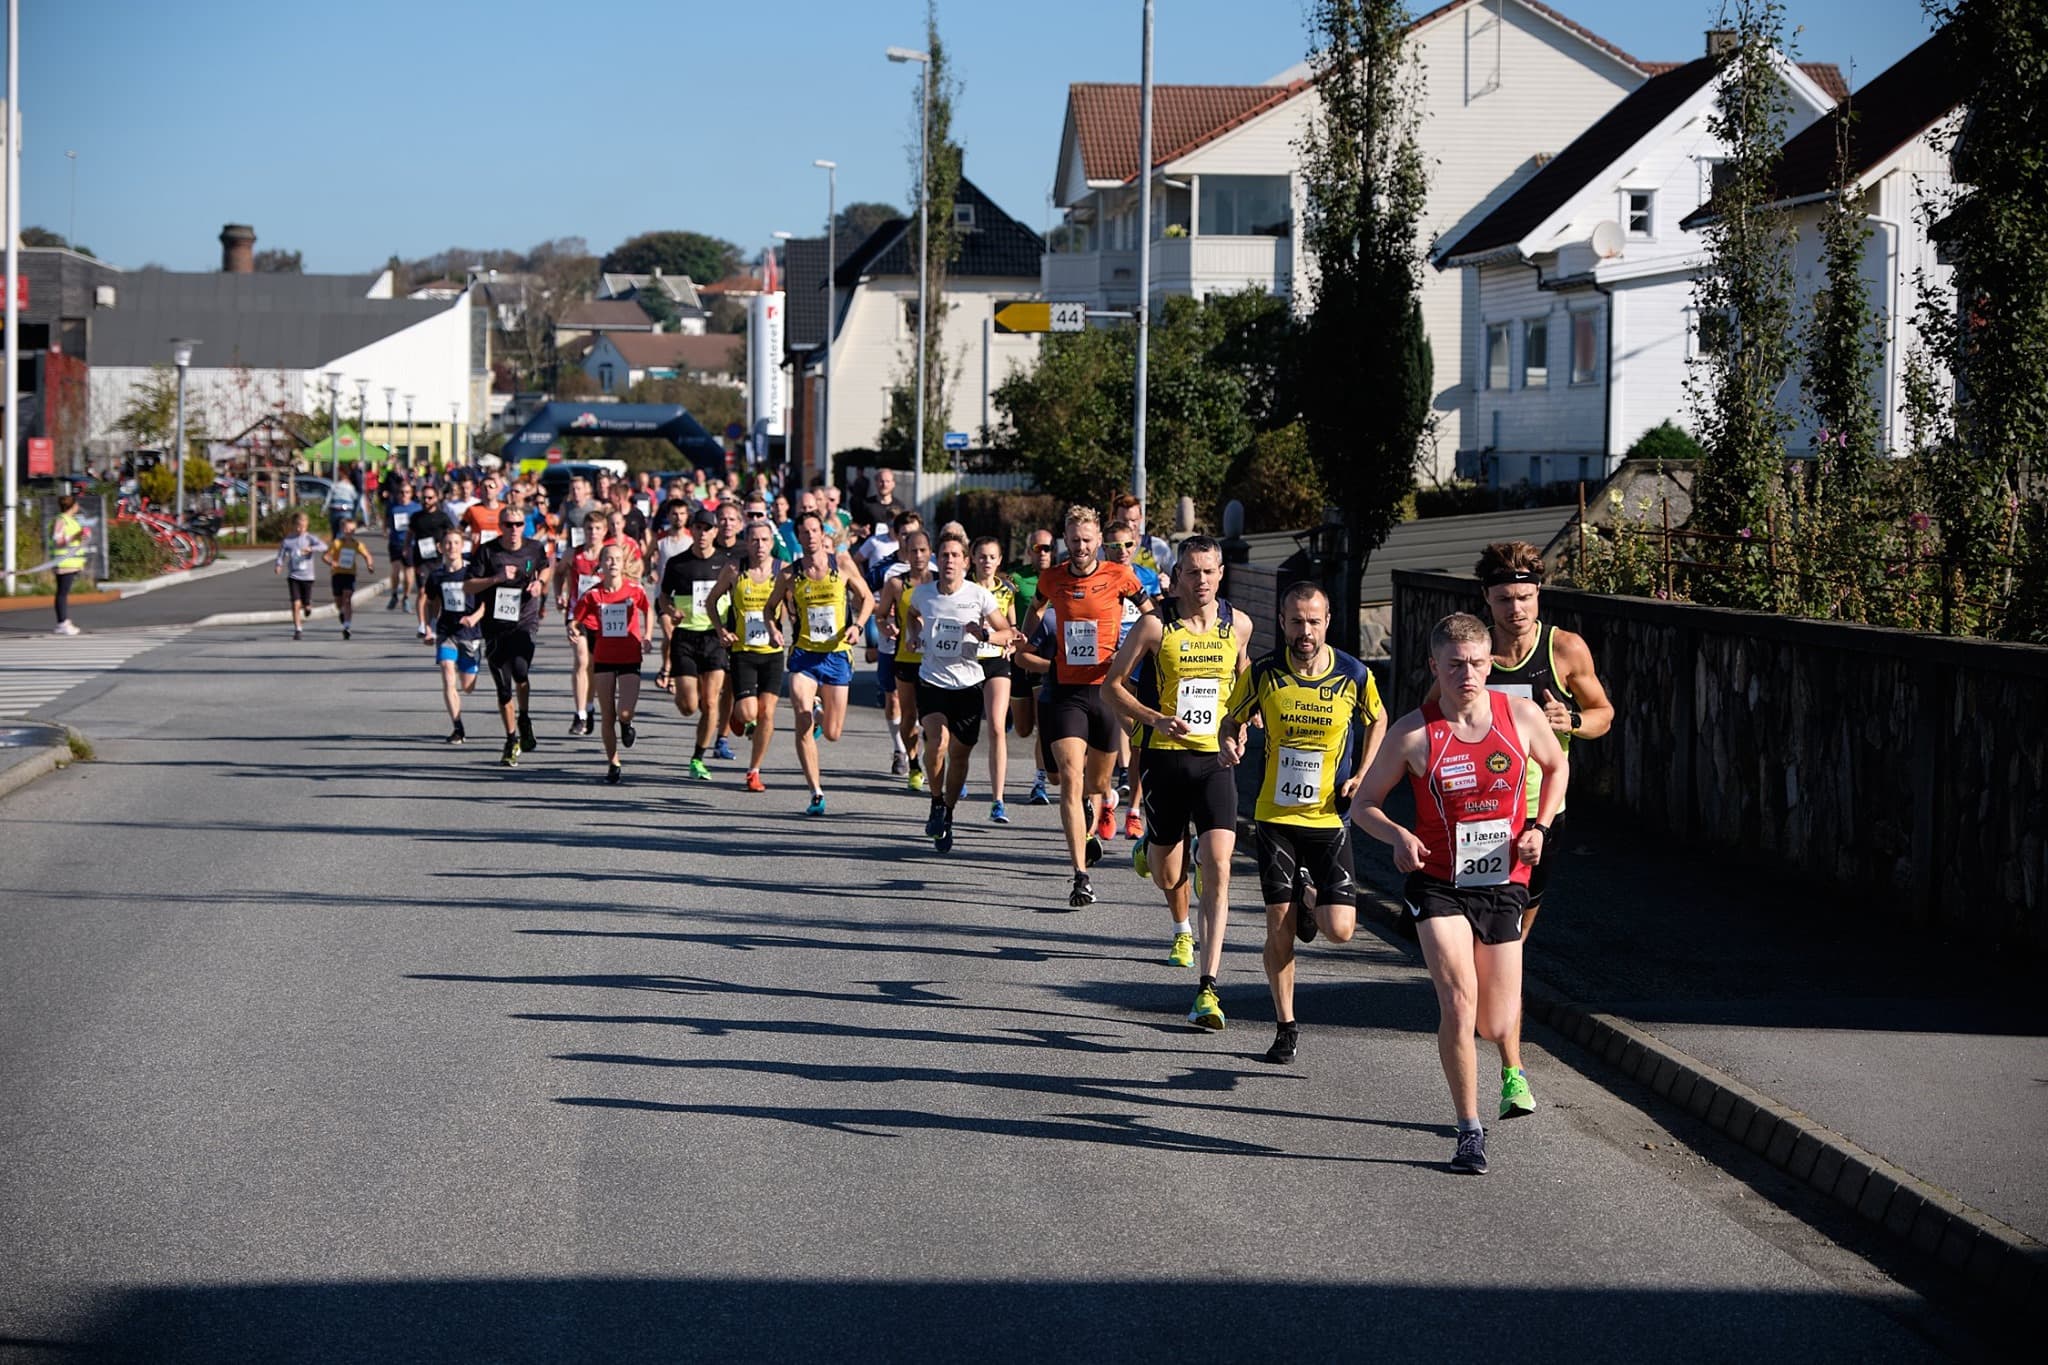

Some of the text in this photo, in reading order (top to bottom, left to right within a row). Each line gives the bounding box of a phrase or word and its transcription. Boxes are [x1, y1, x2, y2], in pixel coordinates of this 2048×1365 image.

[1057, 310, 1078, 324] 44
[498, 605, 516, 615] 420
[606, 621, 625, 631] 317
[814, 625, 833, 634] 464
[936, 640, 958, 651] 467
[1070, 645, 1096, 657] 422
[1190, 641, 1223, 650] FATLAND
[1179, 655, 1223, 663] MAKSIMER
[1191, 685, 1217, 695] jæren
[1294, 700, 1333, 714] Fatland
[1182, 709, 1212, 725] 439
[1280, 713, 1333, 727] MAKSIMER
[1296, 726, 1326, 737] jæren
[1290, 757, 1320, 769] jæren
[1281, 781, 1314, 799] 440
[1474, 830, 1508, 842] jæren
[1463, 857, 1503, 875] 302
